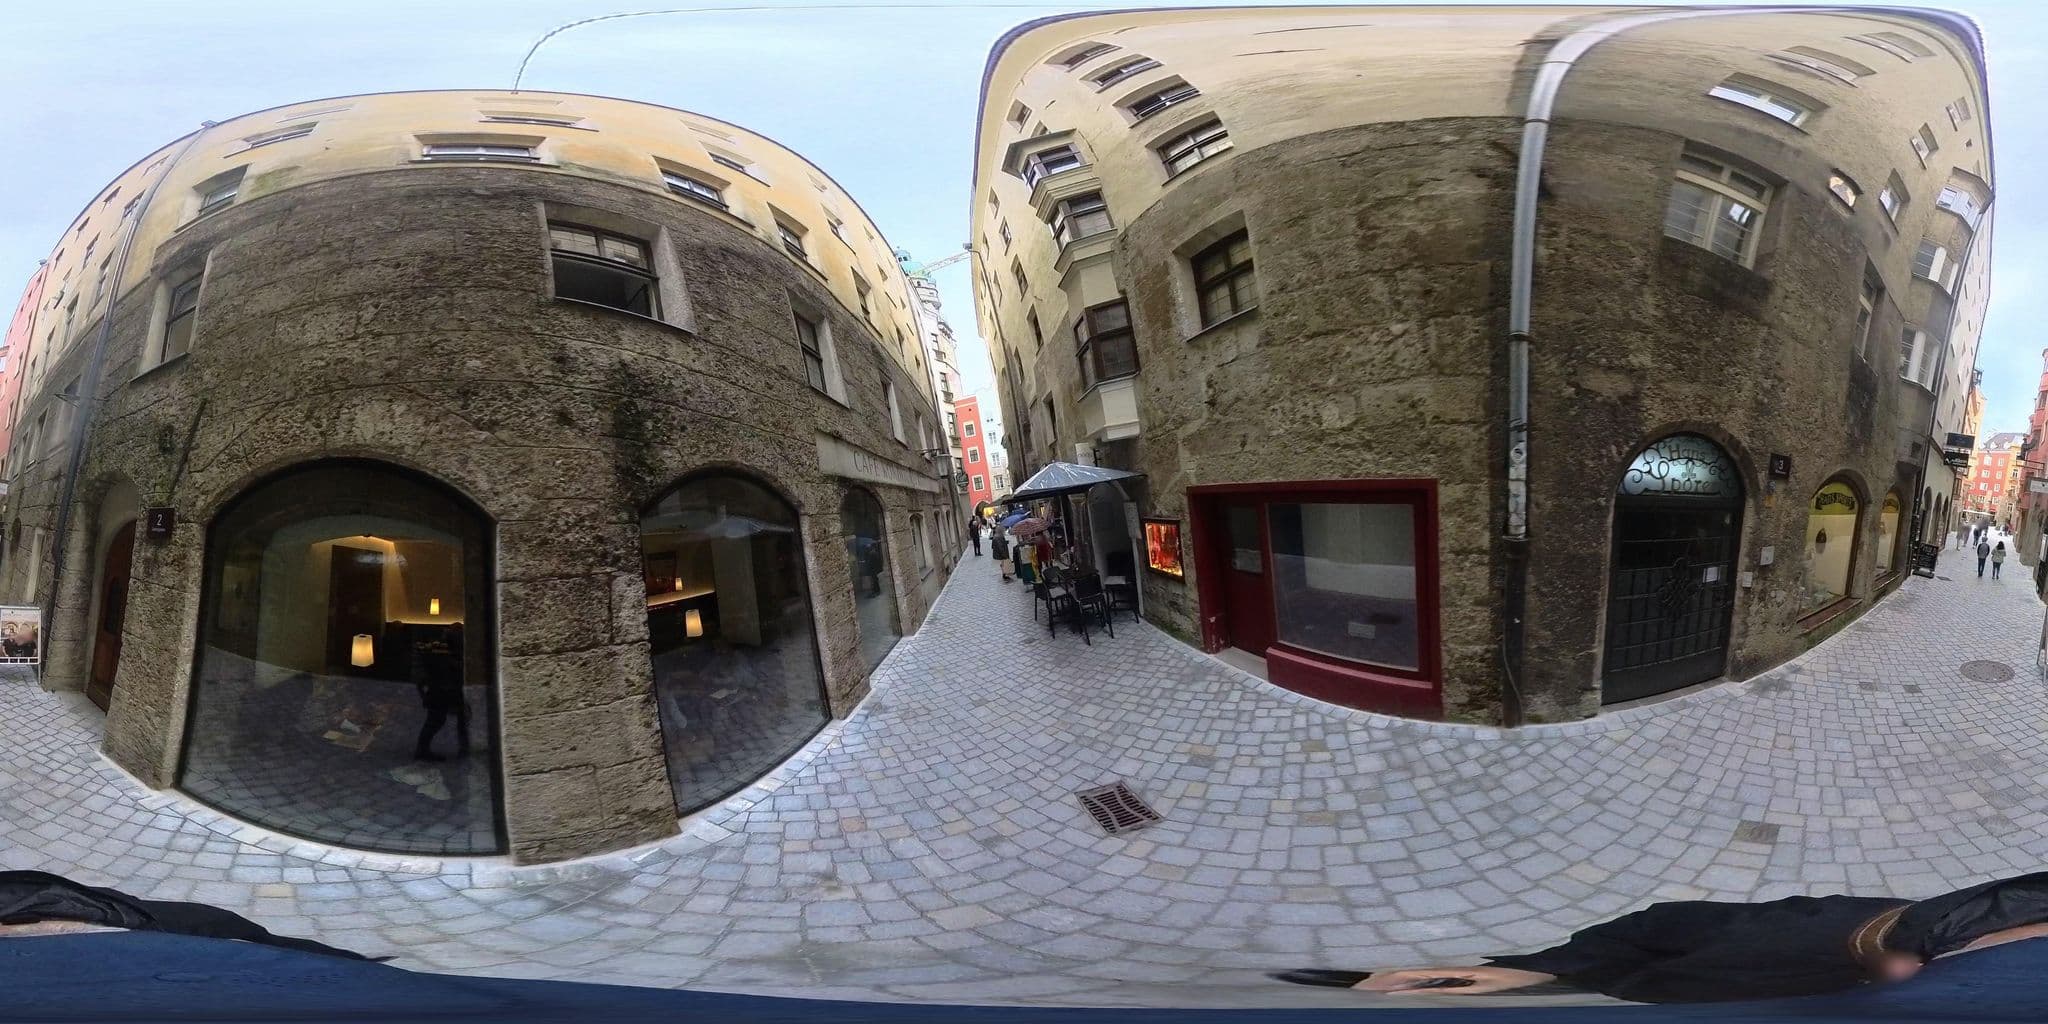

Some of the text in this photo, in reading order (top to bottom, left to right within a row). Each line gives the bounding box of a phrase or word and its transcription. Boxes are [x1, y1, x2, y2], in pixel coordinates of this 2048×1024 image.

[1669, 444, 1705, 460] Hans
[1778, 460, 1784, 470] 3
[157, 514, 163, 526] 2
